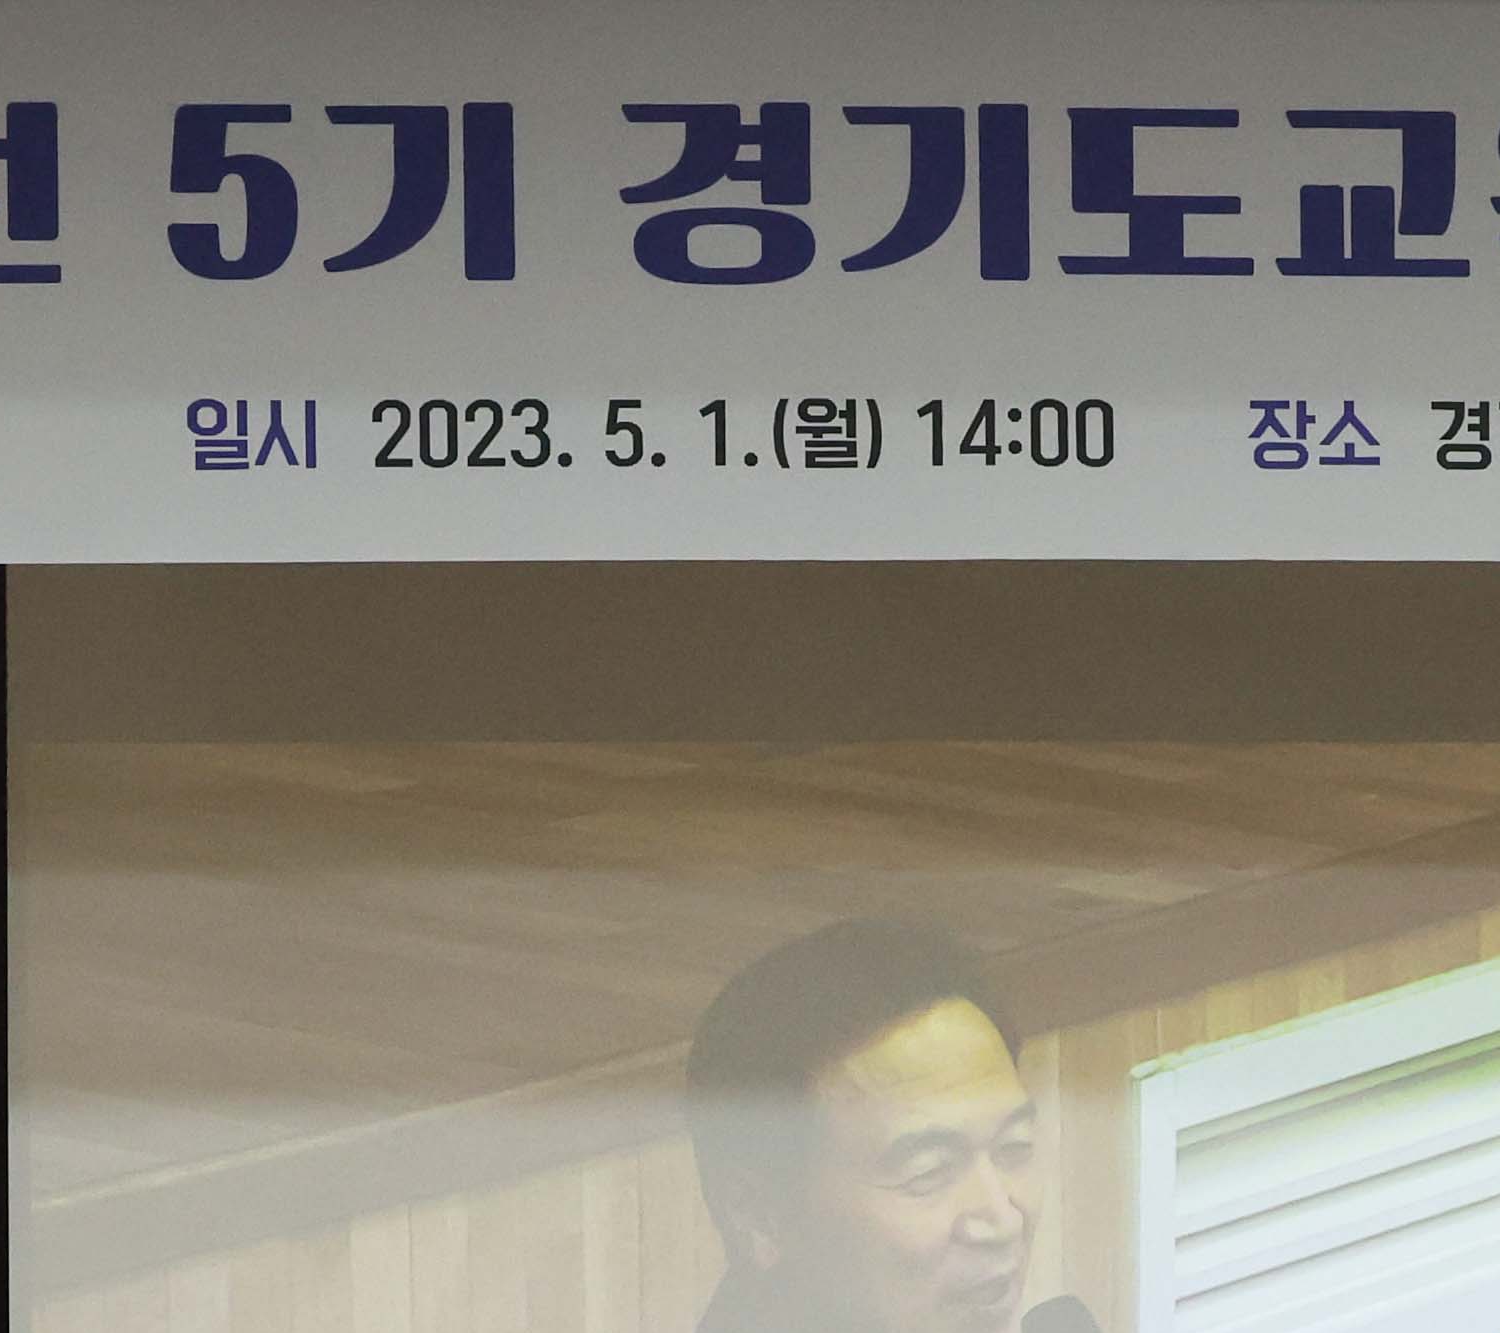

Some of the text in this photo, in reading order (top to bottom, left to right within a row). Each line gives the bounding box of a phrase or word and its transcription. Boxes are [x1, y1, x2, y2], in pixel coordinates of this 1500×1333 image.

[168, 102, 515, 281] 5기
[187, 398, 1114, 470] 일시 2023. 5. 1.(월) 14:00
[1249, 400, 1380, 469] 장소
